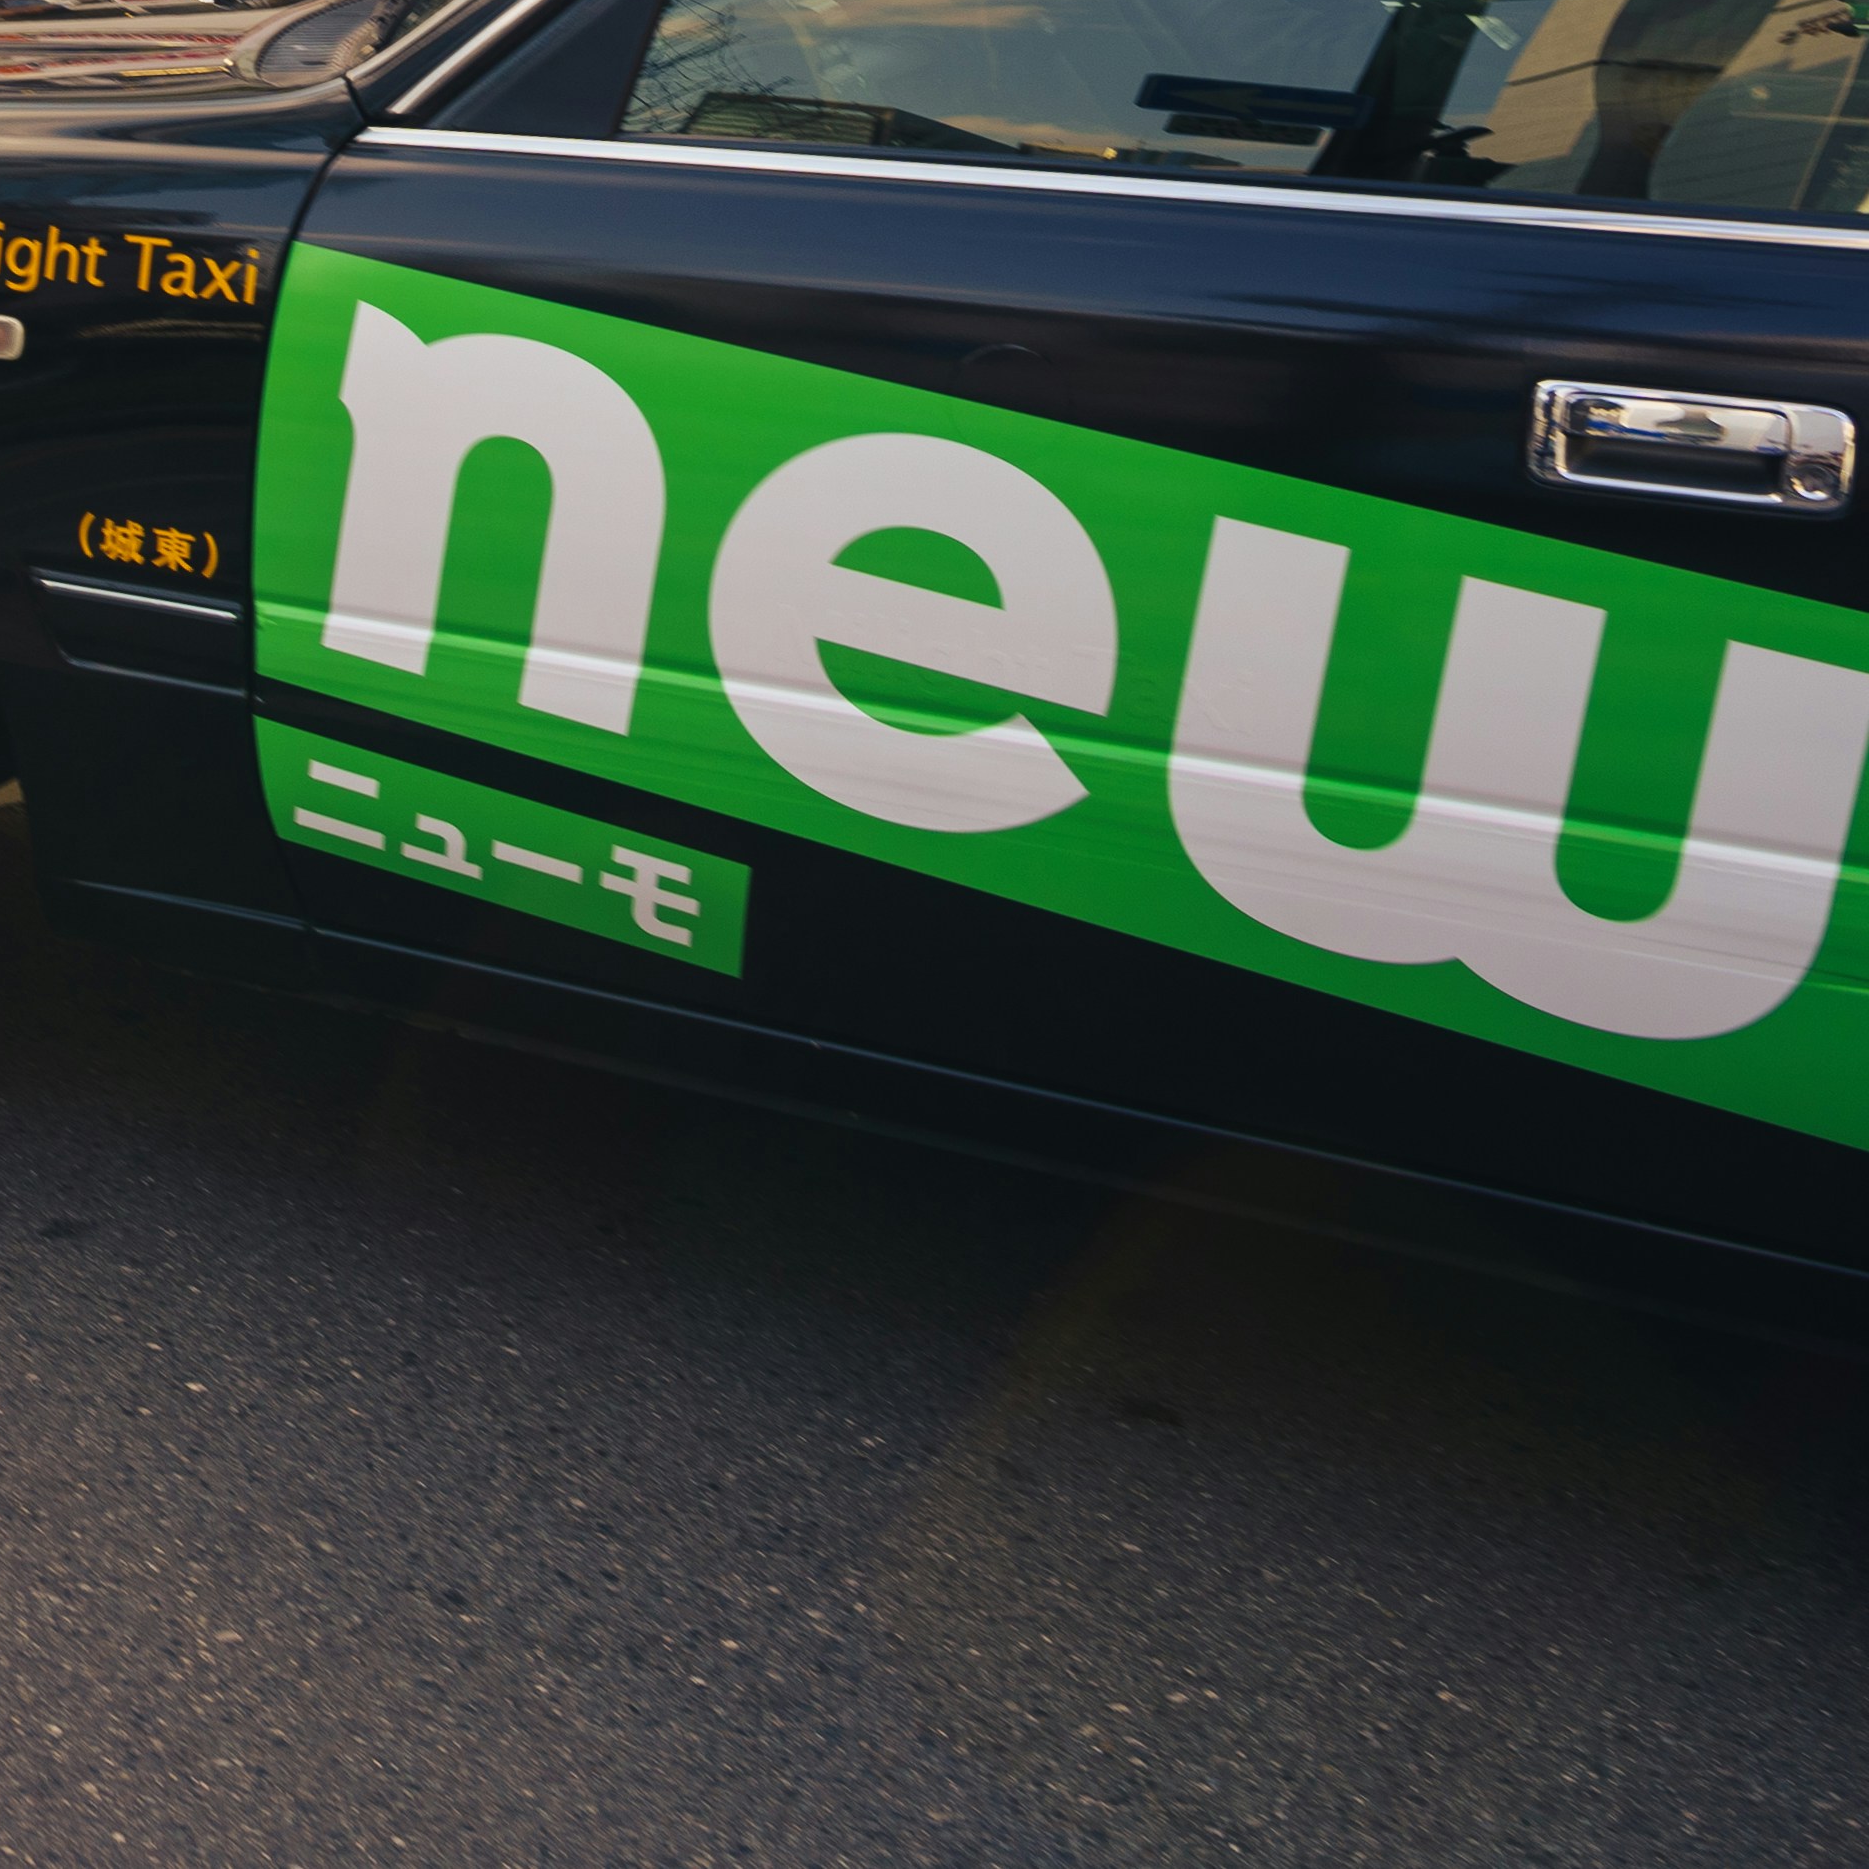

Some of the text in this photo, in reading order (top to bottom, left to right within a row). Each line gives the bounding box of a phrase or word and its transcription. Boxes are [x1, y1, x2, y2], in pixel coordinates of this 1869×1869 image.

[124, 234, 260, 305] Taxi
[321, 298, 1869, 1042] new
[292, 758, 701, 949] ニューモ
